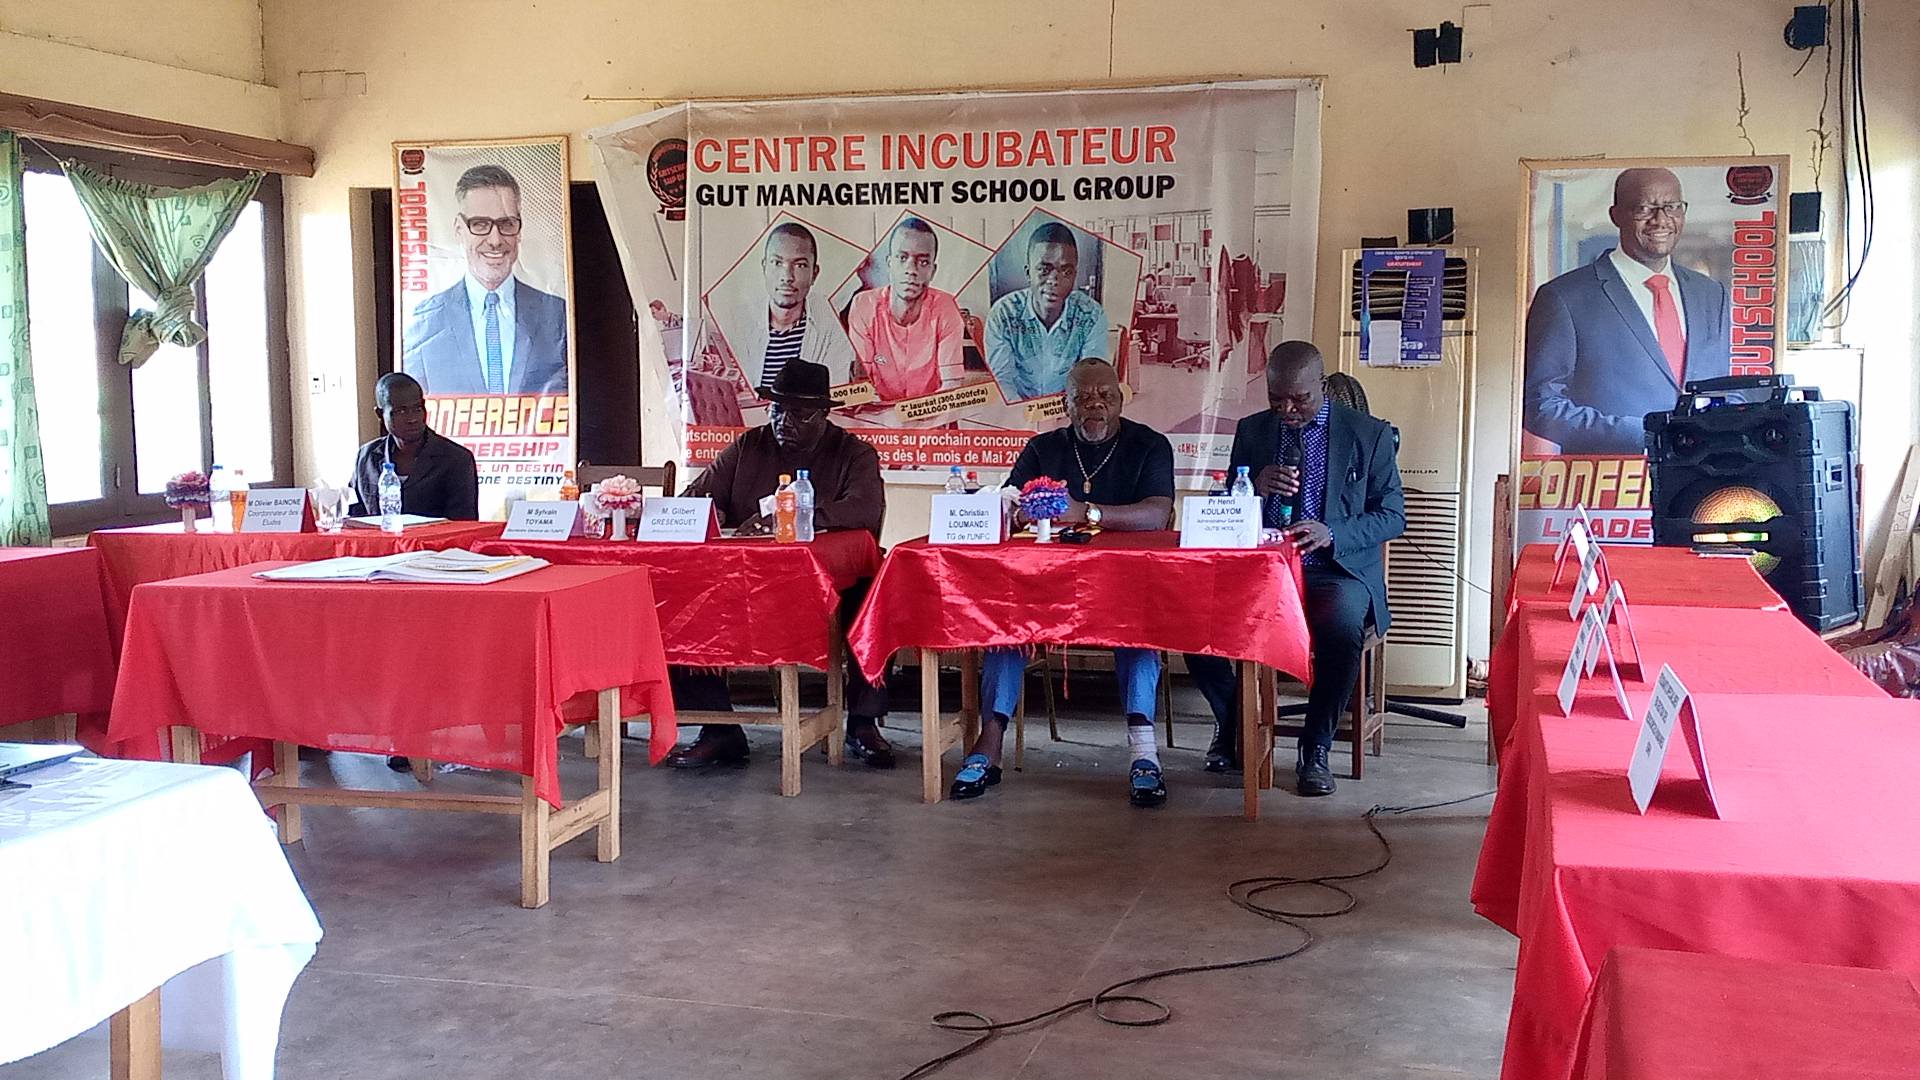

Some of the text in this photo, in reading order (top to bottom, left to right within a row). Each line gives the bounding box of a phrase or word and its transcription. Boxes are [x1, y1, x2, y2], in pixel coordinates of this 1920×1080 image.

[694, 135, 866, 173] CENTRE
[881, 126, 1176, 170] INCUBATEUR
[696, 175, 1176, 206] GUT MANAGEMENT SCHOOL GROUP
[400, 181, 428, 291] GUTSCHOOL
[424, 396, 569, 437] ONFERENCE
[902, 434, 917, 446] au
[920, 433, 971, 450] prochain
[973, 436, 1030, 447] concours
[892, 449, 914, 461] dès
[916, 449, 927, 461] le
[932, 450, 961, 463] mois
[964, 450, 979, 463] de
[981, 450, 1003, 464] Mai
[1005, 451, 1021, 464] 20
[506, 476, 563, 485] DESTINY
[1519, 459, 1651, 509] CONFE
[535, 508, 557, 516] Sylvain
[672, 507, 696, 515] Gilbert
[959, 508, 989, 516] Christian
[948, 520, 989, 528] LOUMANDE
[1541, 517, 1652, 538] LADE
